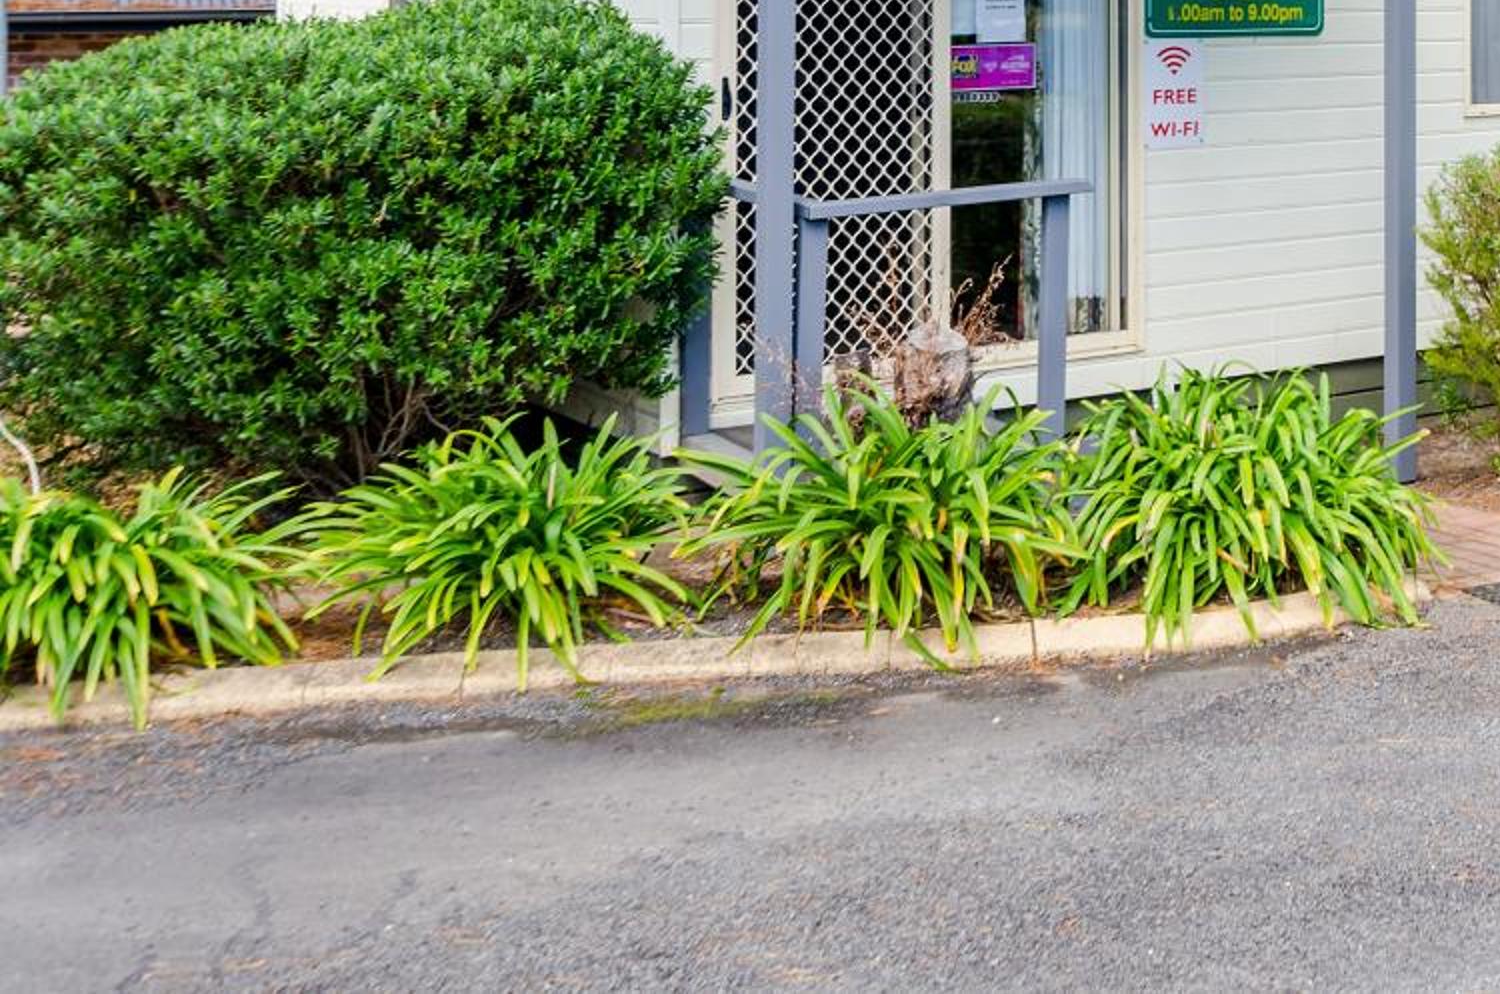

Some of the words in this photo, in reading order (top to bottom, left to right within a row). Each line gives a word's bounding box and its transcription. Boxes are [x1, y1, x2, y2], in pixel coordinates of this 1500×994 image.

[1229, 4, 1244, 22] to
[1247, 4, 1304, 25] 9.00pm
[1153, 88, 1197, 105] FREE
[1151, 121, 1199, 137] WI-FI
